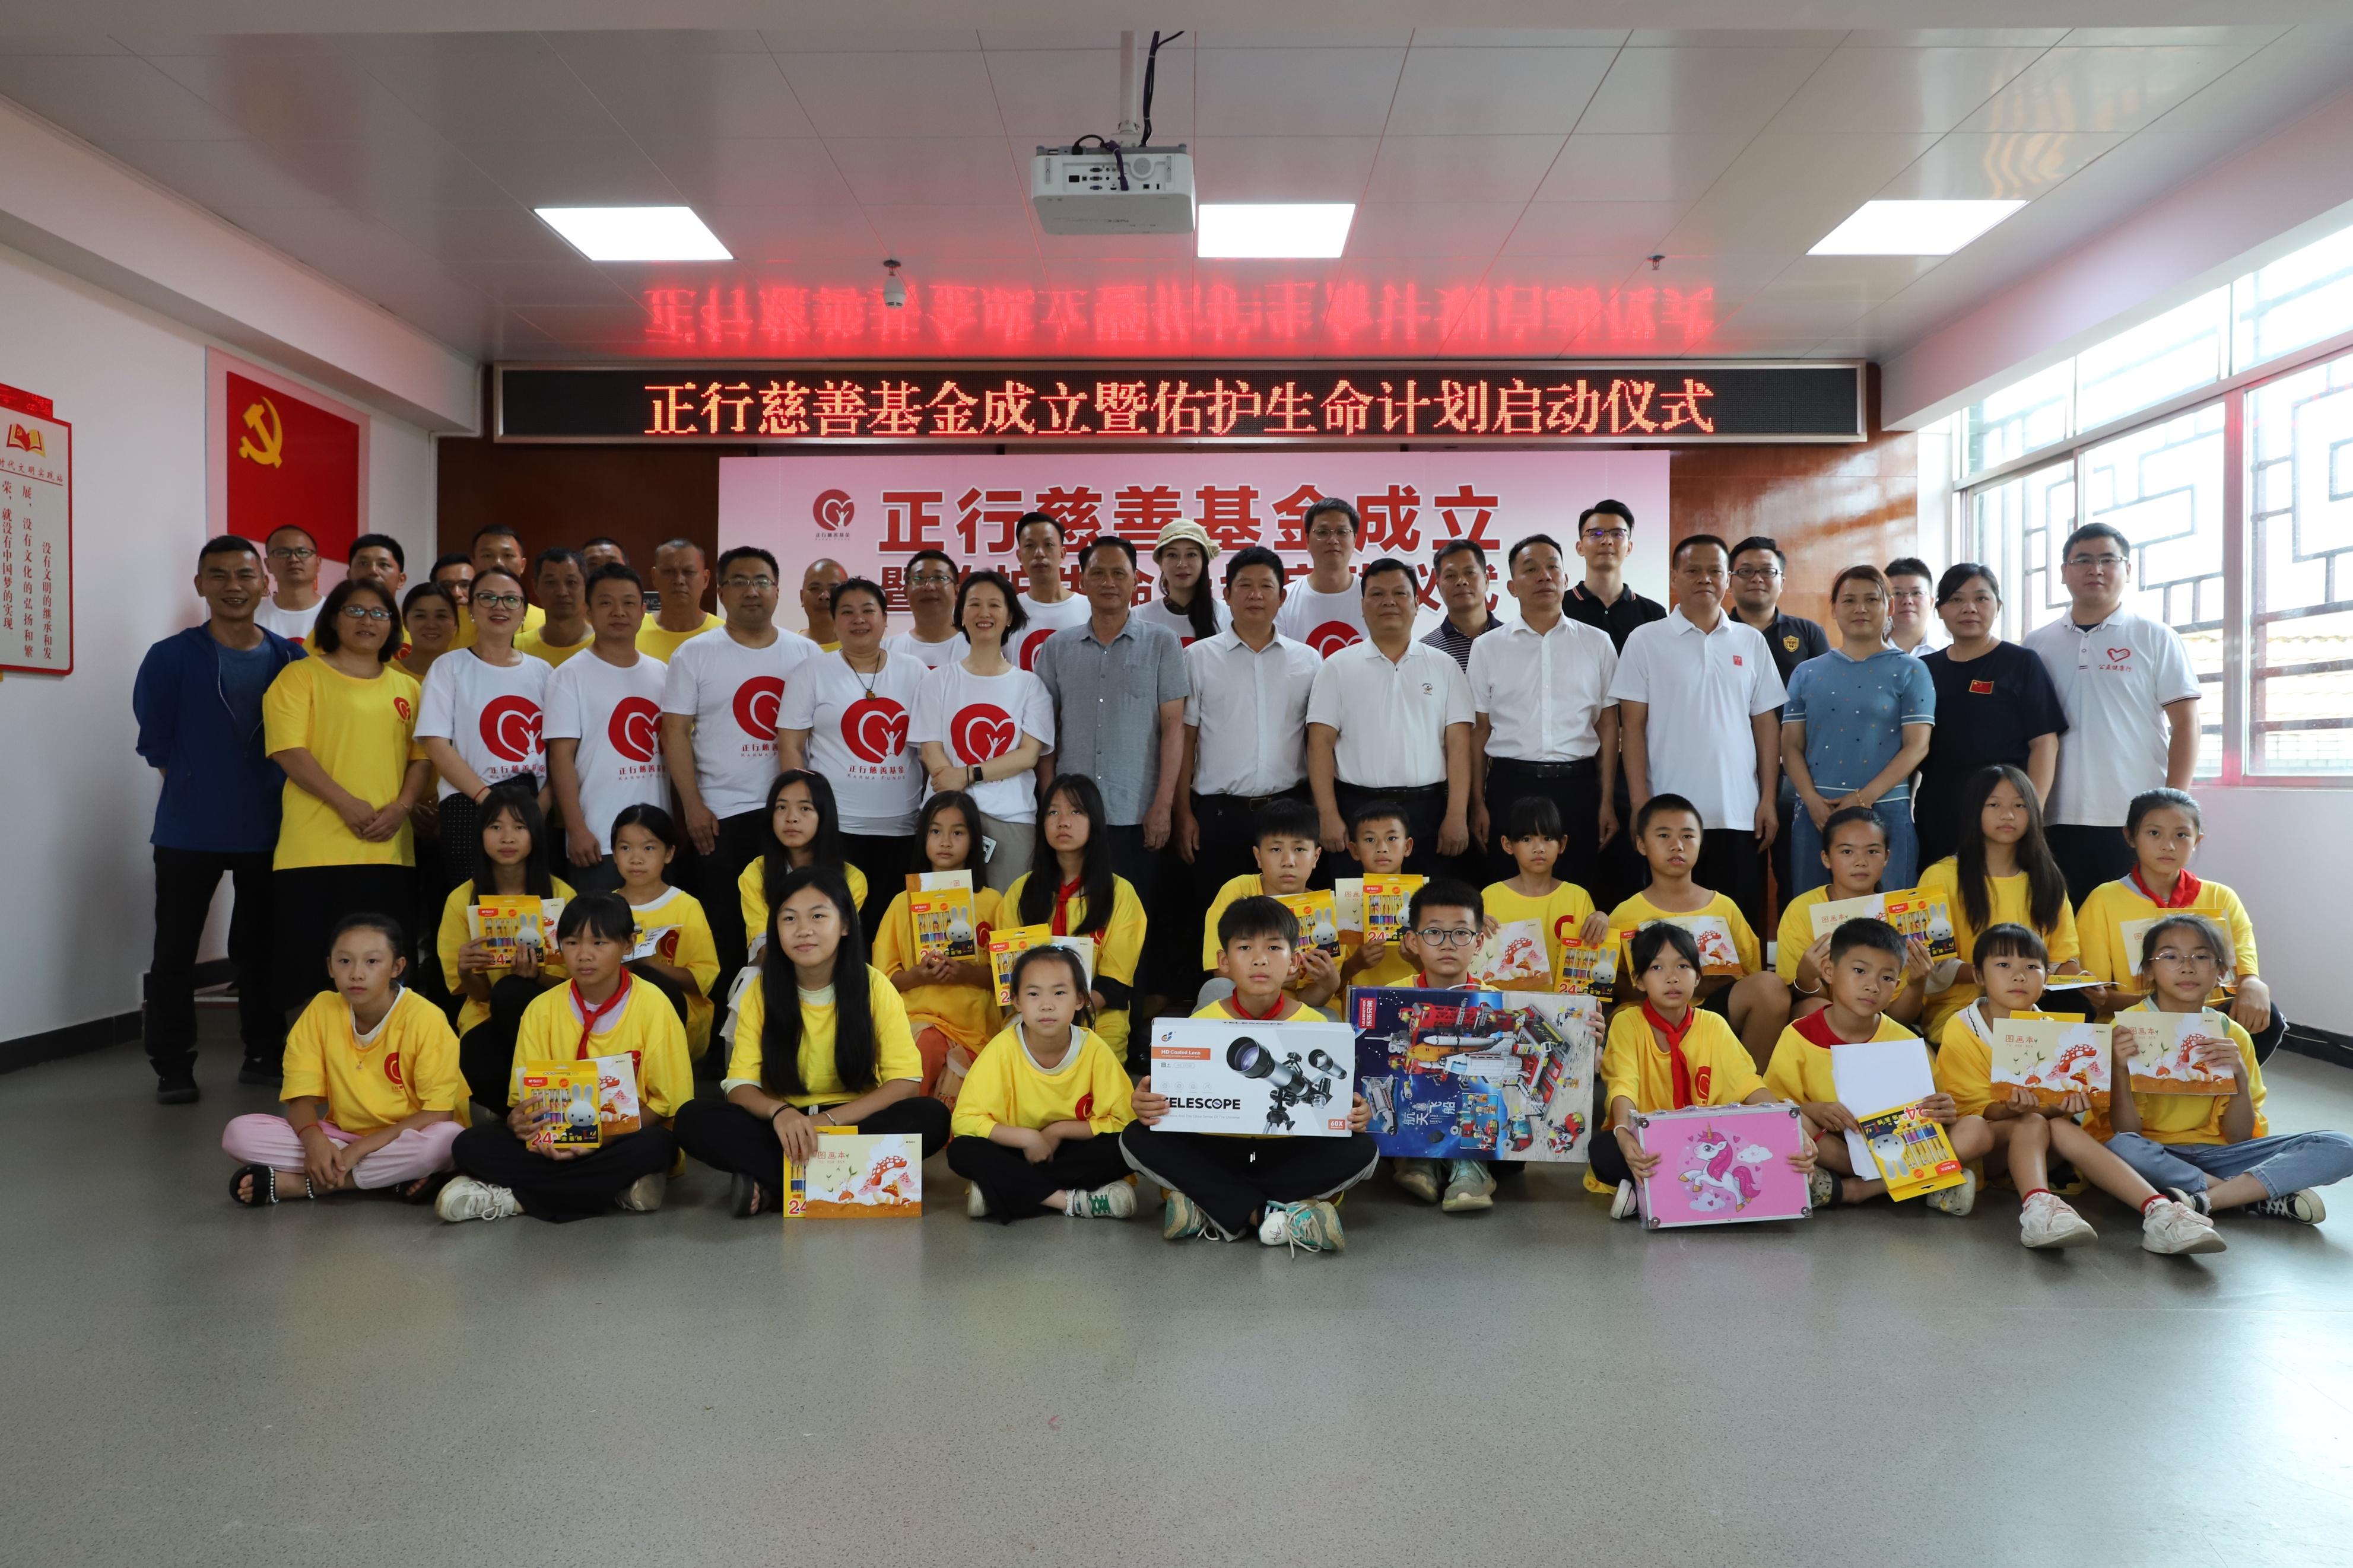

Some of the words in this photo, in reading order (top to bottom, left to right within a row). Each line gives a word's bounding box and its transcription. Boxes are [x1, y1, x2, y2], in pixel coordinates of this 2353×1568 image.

[644, 379, 1714, 435] 正行慈善基金成立暨佑护生命计划启动仪式
[43, 542, 52, 660] 没有文明的继承和发
[849, 765, 904, 774] 正行慈善基金
[1559, 982, 1577, 994] 24
[2006, 1035, 2033, 1044] 图画本
